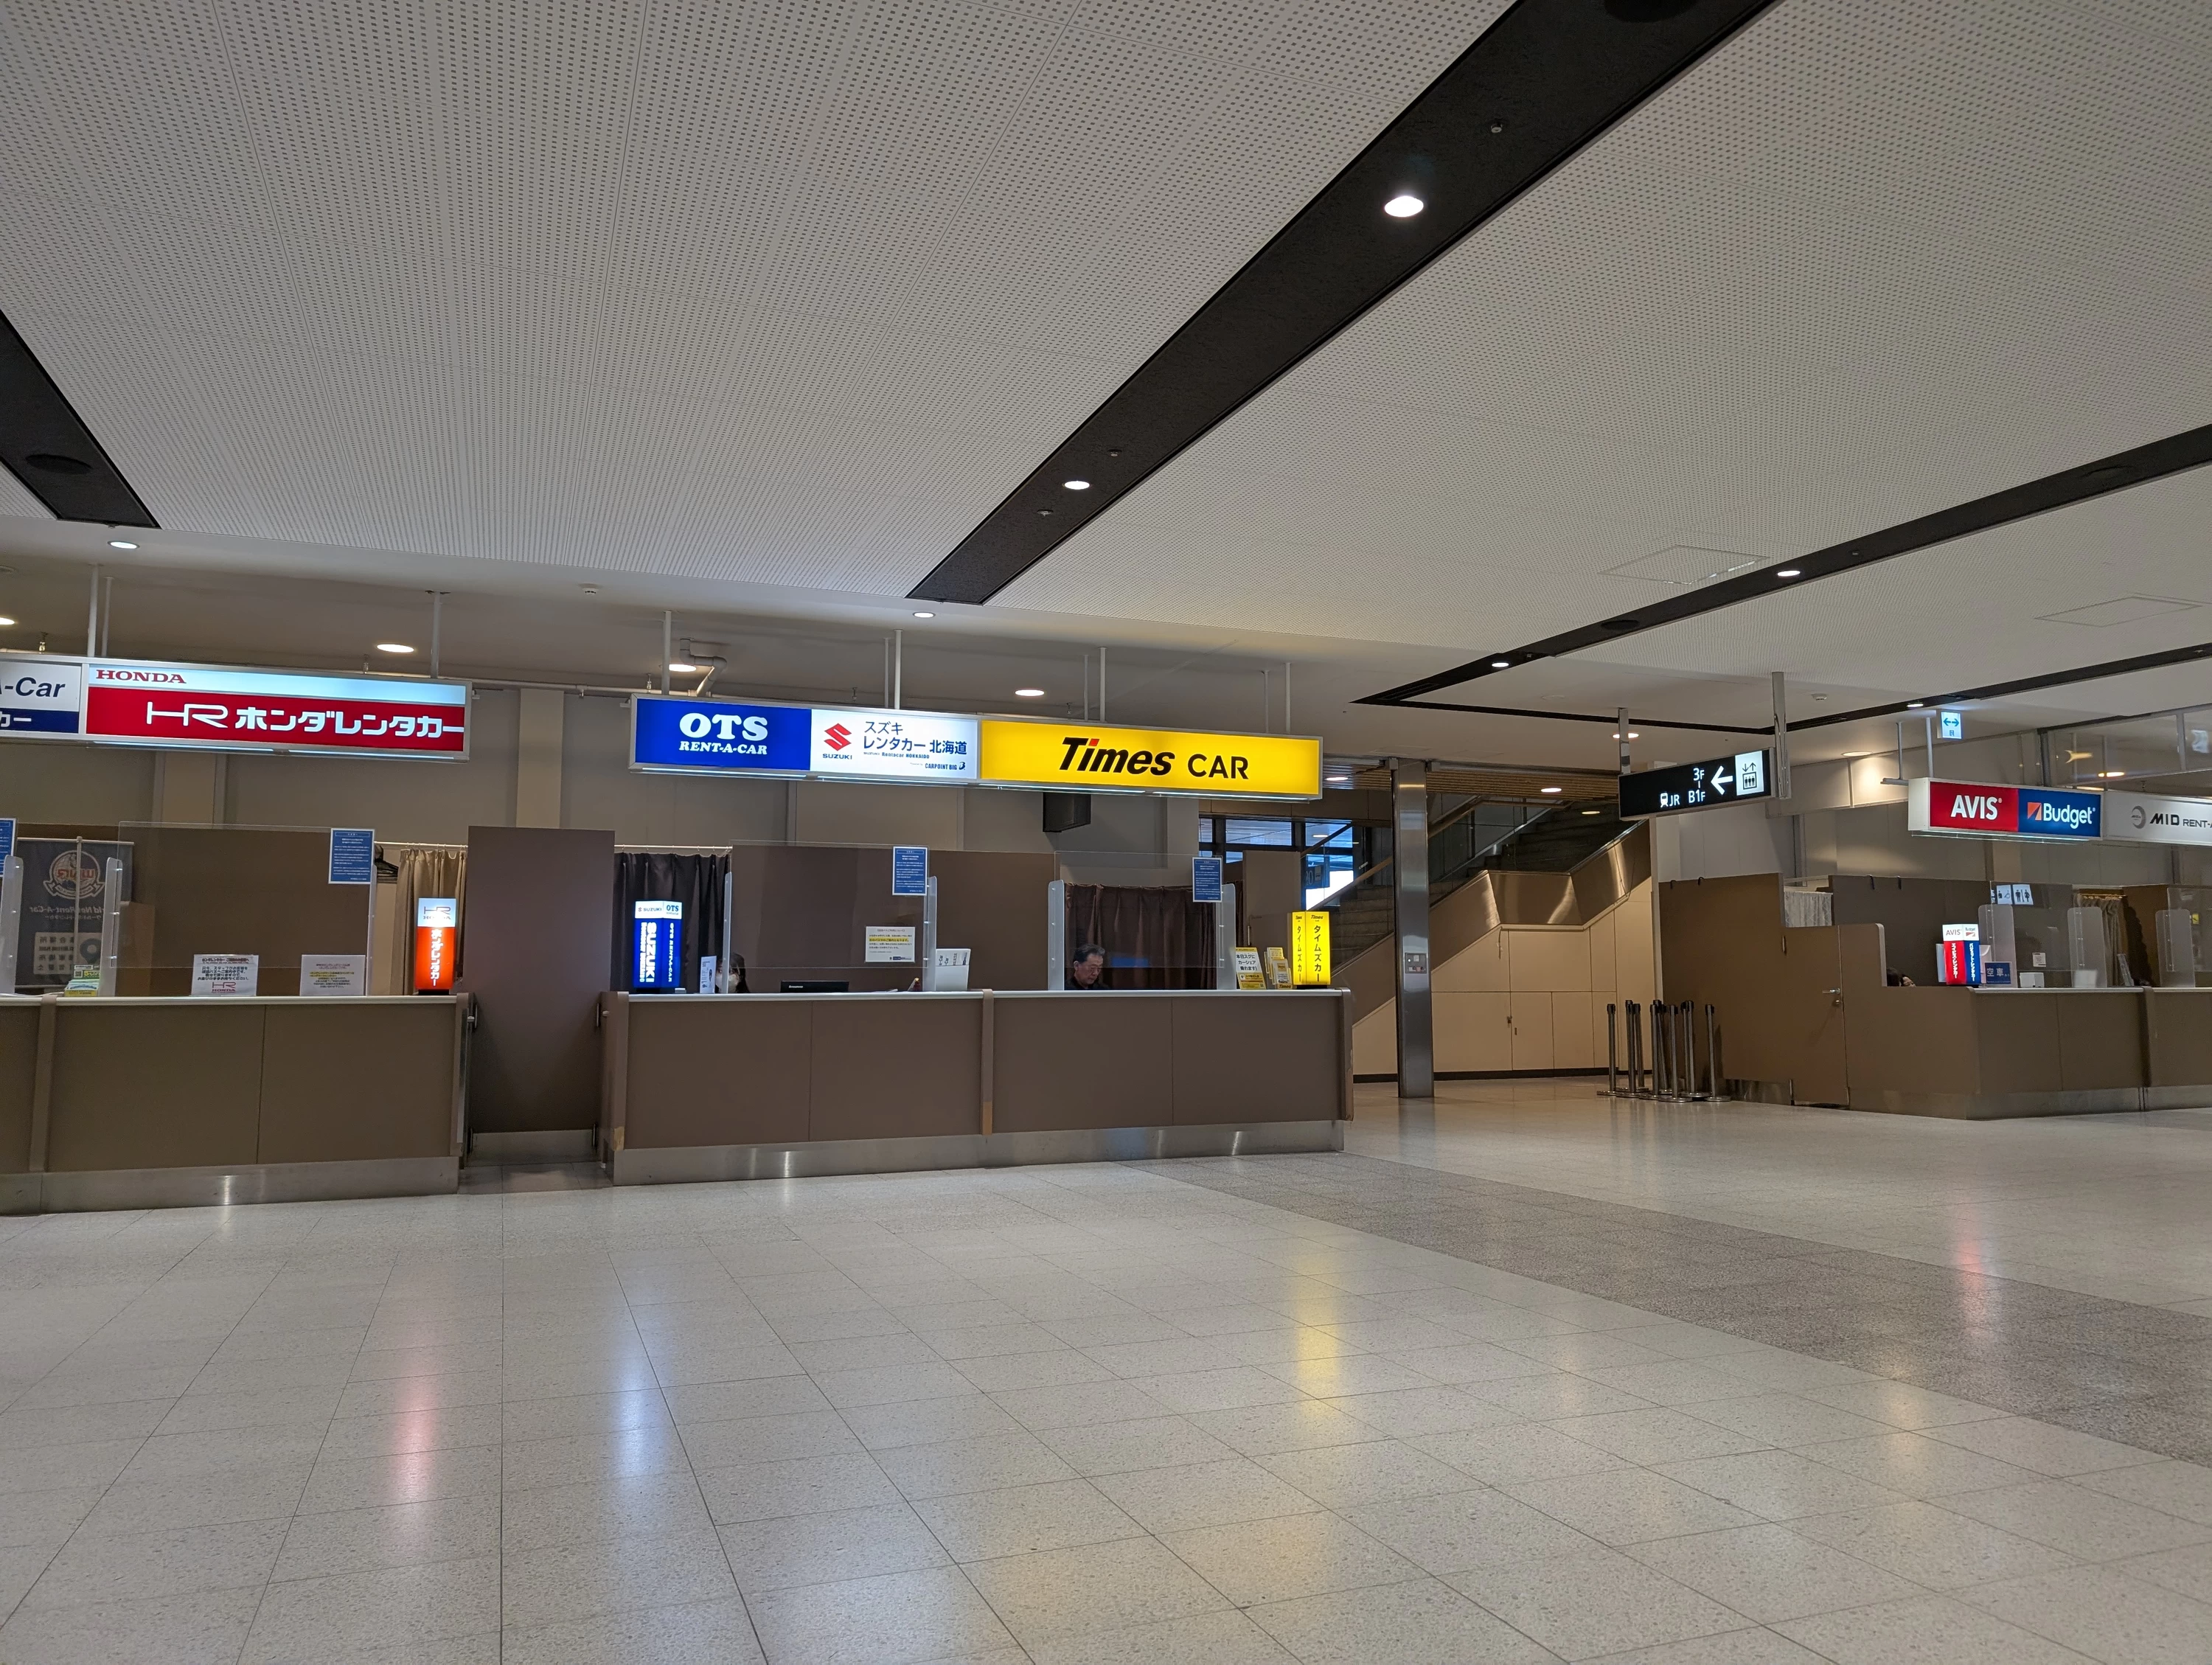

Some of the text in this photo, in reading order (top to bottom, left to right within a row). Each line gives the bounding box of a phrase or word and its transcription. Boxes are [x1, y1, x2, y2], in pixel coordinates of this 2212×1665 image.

[96, 669, 187, 684] HONDA
[0, 677, 65, 698] -Car
[234, 706, 465, 738] ホンダレンタカー
[679, 712, 768, 741] OTS
[864, 720, 903, 735] スズキ
[678, 741, 768, 755] RENT-A-CAR
[863, 736, 967, 755] レンタカー 北海道
[925, 762, 948, 771] CARPOINT
[1059, 737, 1249, 780] Times CAR
[1693, 768, 1705, 781] 3F
[1669, 789, 1705, 807] JR B1F
[1950, 795, 1998, 820] AVIS
[2043, 802, 2093, 830] Budget
[2150, 813, 2180, 826] MID
[2183, 818, 2212, 828] RENT-
[646, 922, 657, 983] SUZUKI
[1314, 925, 1322, 982] タイムズカー
